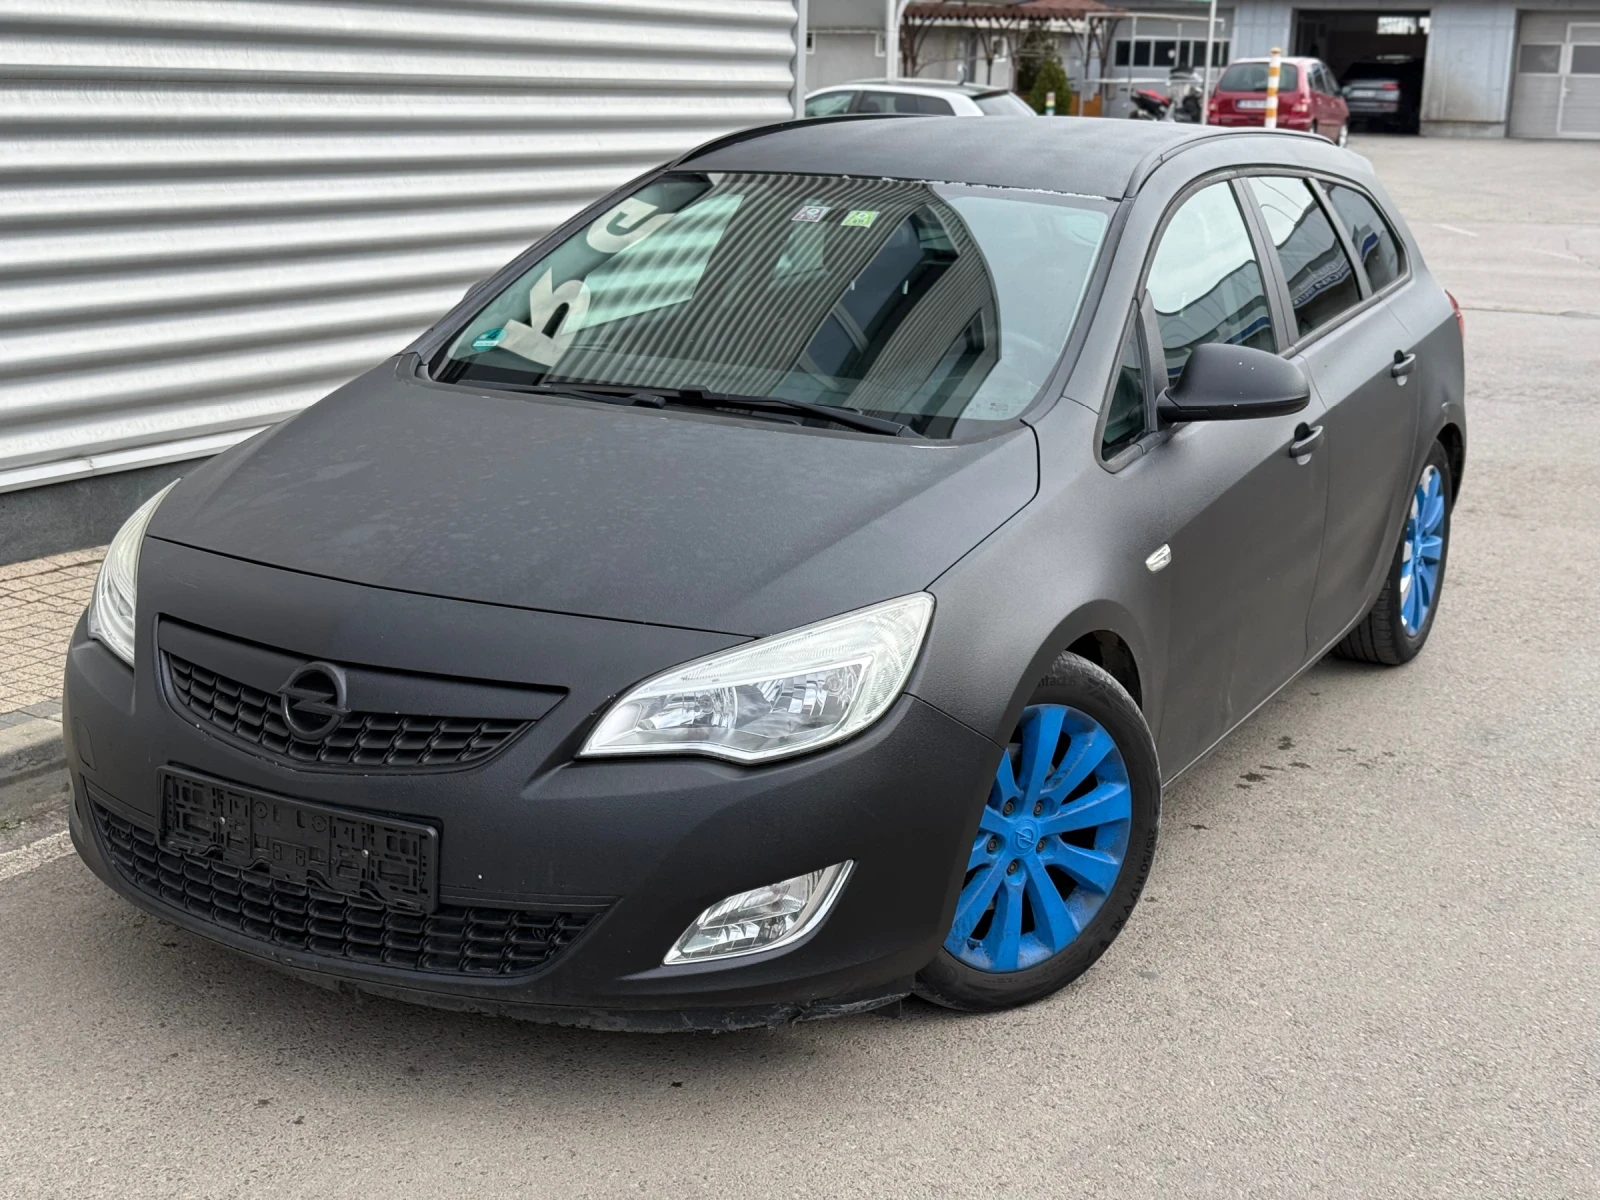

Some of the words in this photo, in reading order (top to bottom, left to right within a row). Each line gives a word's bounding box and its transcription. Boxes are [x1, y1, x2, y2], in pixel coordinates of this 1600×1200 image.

[1140, 828, 1157, 873] 215/50
[1135, 875, 1145, 885] R
[1129, 888, 1140, 901] 17
[1110, 916, 1125, 932] XL
